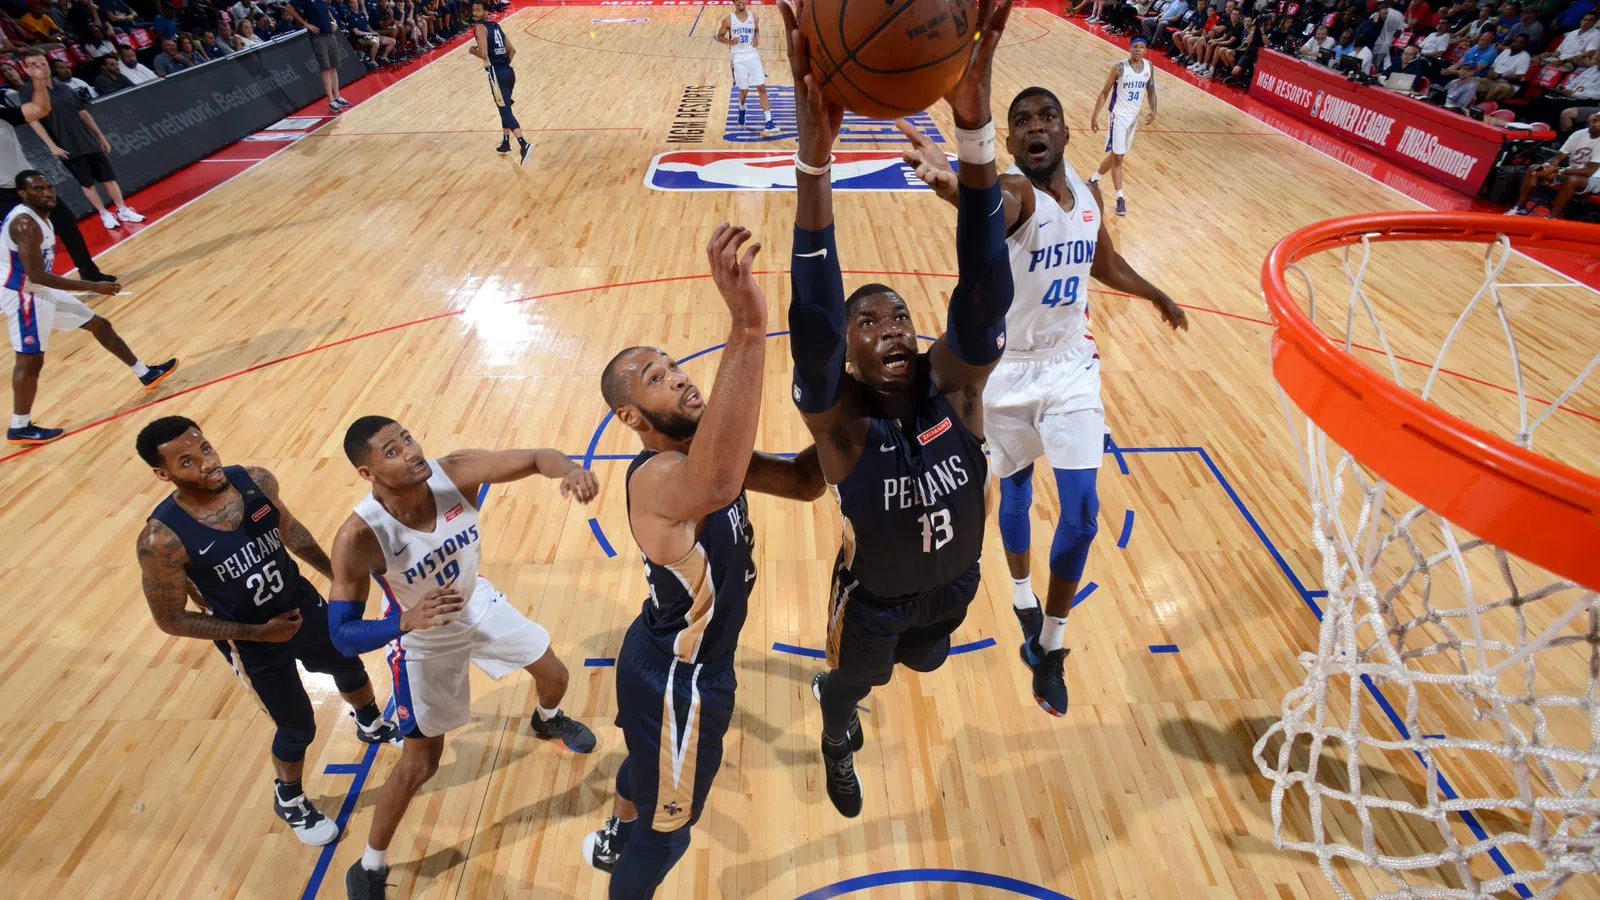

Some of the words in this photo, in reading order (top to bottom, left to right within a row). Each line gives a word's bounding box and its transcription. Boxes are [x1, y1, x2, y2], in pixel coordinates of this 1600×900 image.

[494, 29, 504, 47] 41
[740, 35, 749, 43] 38
[676, 85, 716, 118] RESORTS
[1123, 81, 1146, 89] PISTON
[1128, 91, 1140, 101] 34
[108, 126, 156, 155] Best
[155, 102, 221, 139] network.
[214, 90, 251, 117] Best
[248, 64, 301, 101] unlimited.
[1256, 71, 1276, 92] MGM
[1275, 80, 1313, 109] RESORTS
[1319, 94, 1361, 133] SUMMER
[1355, 108, 1396, 147] LEAGUE
[1396, 125, 1479, 180] #NBASummer
[666, 121, 708, 143] MGM
[1028, 240, 1096, 273] PISTON
[1041, 276, 1080, 308] 49
[917, 508, 955, 553] 13
[213, 527, 281, 582] PELICANS
[401, 524, 479, 585] PISTONS
[246, 560, 284, 607] 25
[435, 559, 460, 587] 19
